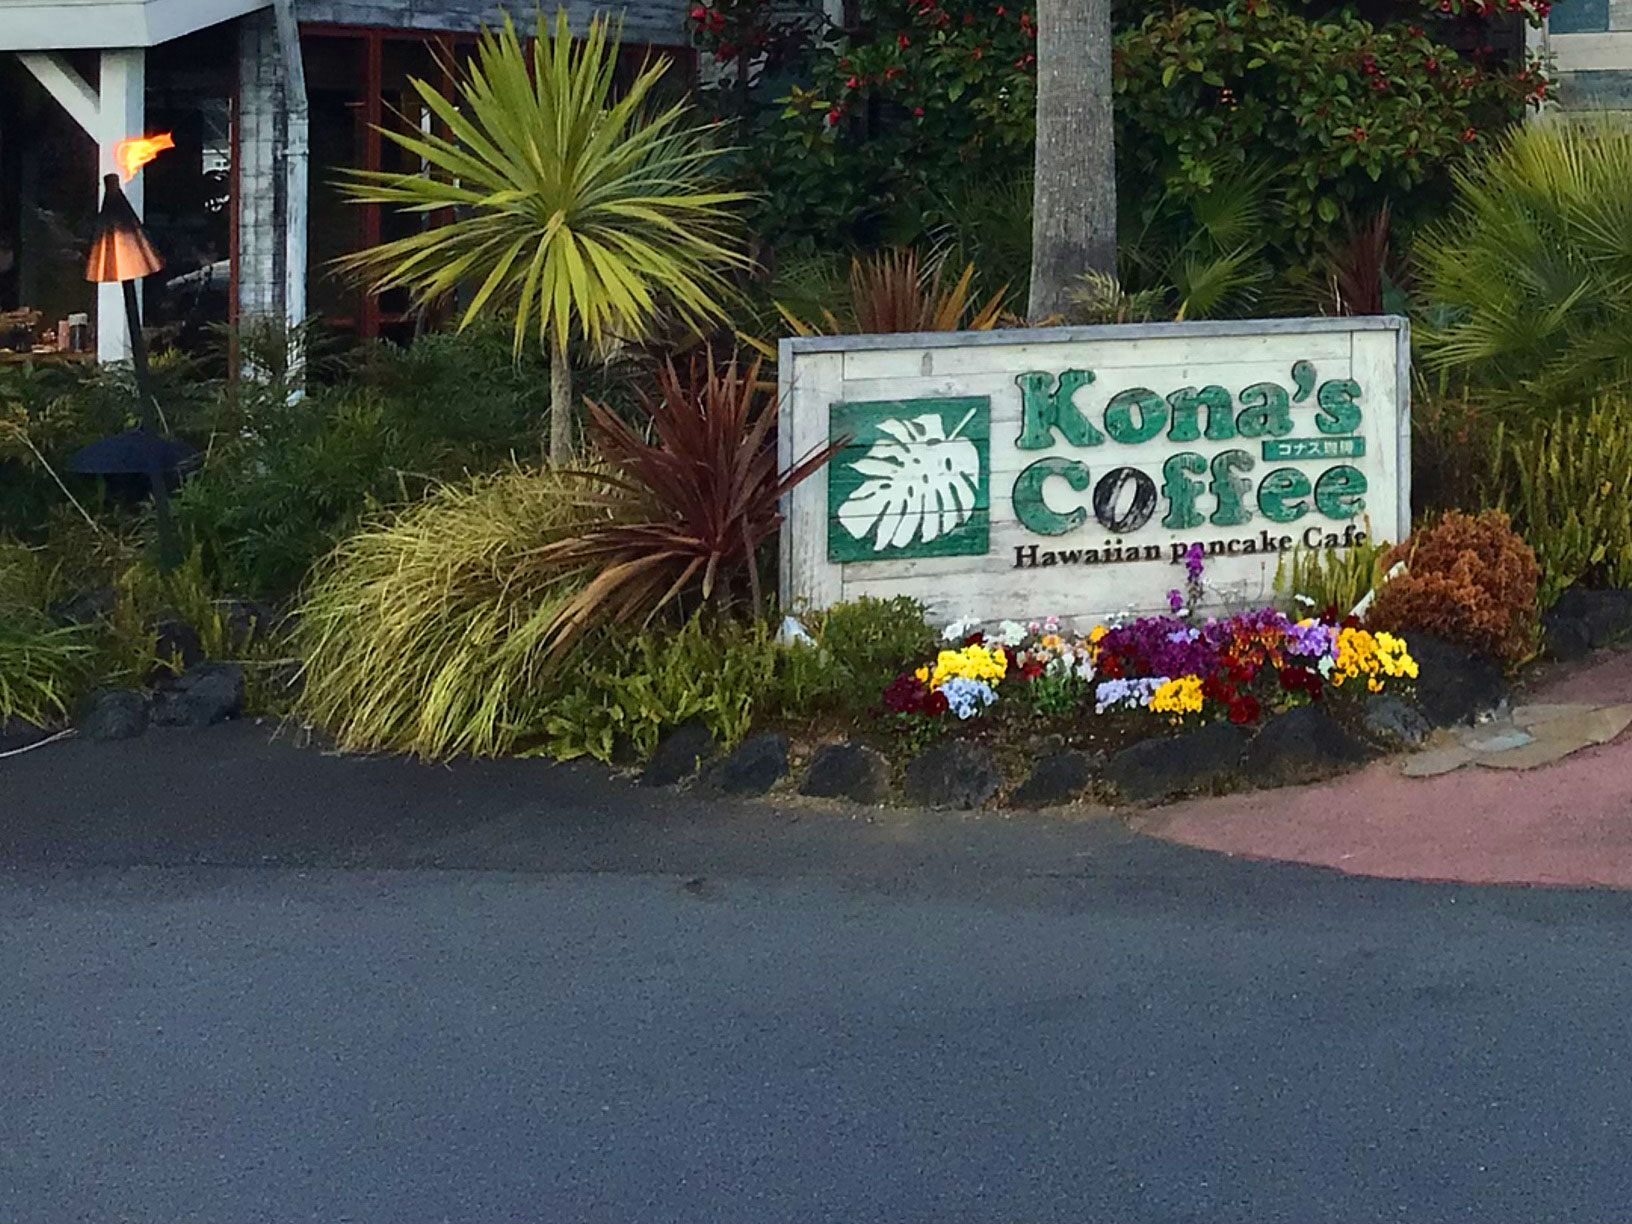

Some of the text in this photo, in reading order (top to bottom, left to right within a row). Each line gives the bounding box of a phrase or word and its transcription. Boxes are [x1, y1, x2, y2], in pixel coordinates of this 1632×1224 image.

[1015, 360, 1362, 450] Kona's
[1012, 449, 1368, 536] Coffee
[1014, 540, 1161, 568] Hawaiian
[1303, 524, 1366, 550] Cafe
